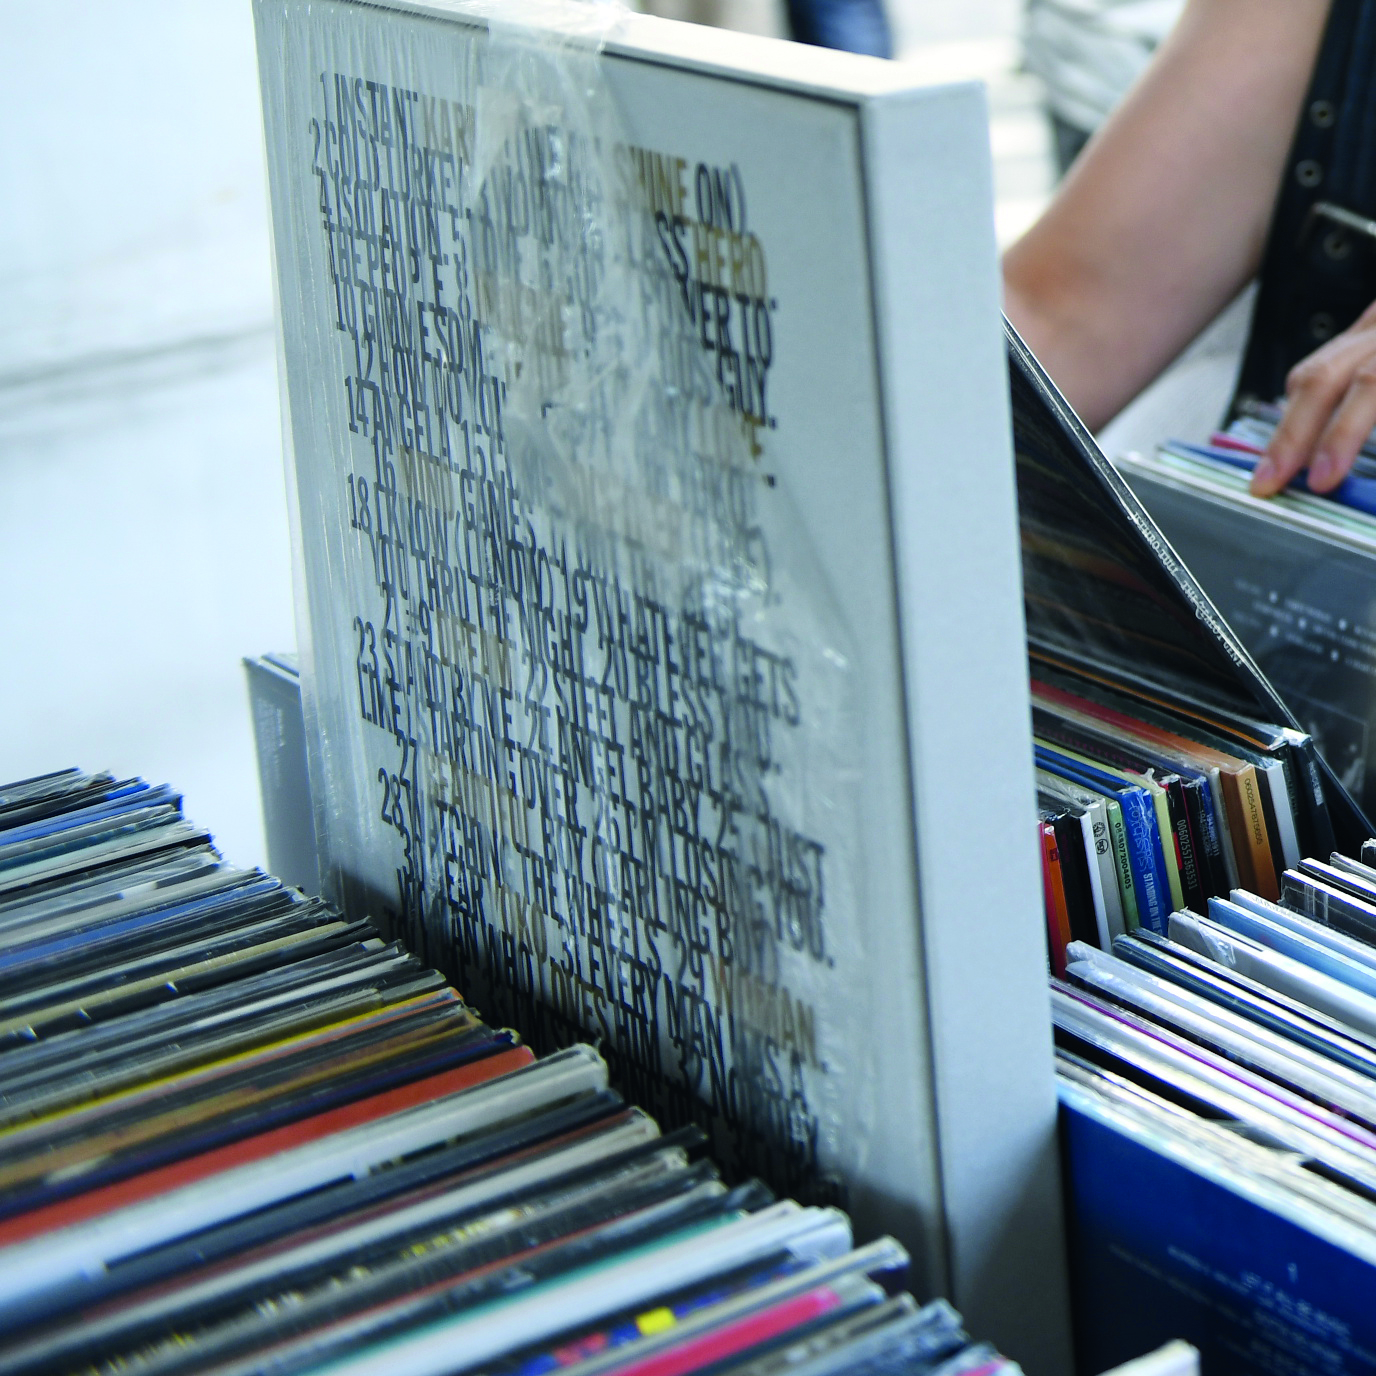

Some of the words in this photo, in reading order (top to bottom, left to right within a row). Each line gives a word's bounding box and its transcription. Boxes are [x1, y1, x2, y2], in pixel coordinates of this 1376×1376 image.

[334, 73, 421, 152] INSTANT
[1128, 509, 1164, 553] JETHRO
[1157, 547, 1181, 575] TULL
[1222, 639, 1245, 666] GENE
[352, 613, 379, 681] 23
[377, 767, 406, 836] 28
[1144, 872, 1158, 907] STANDING
[1150, 906, 1161, 918] ON
[1152, 917, 1163, 929] THE
